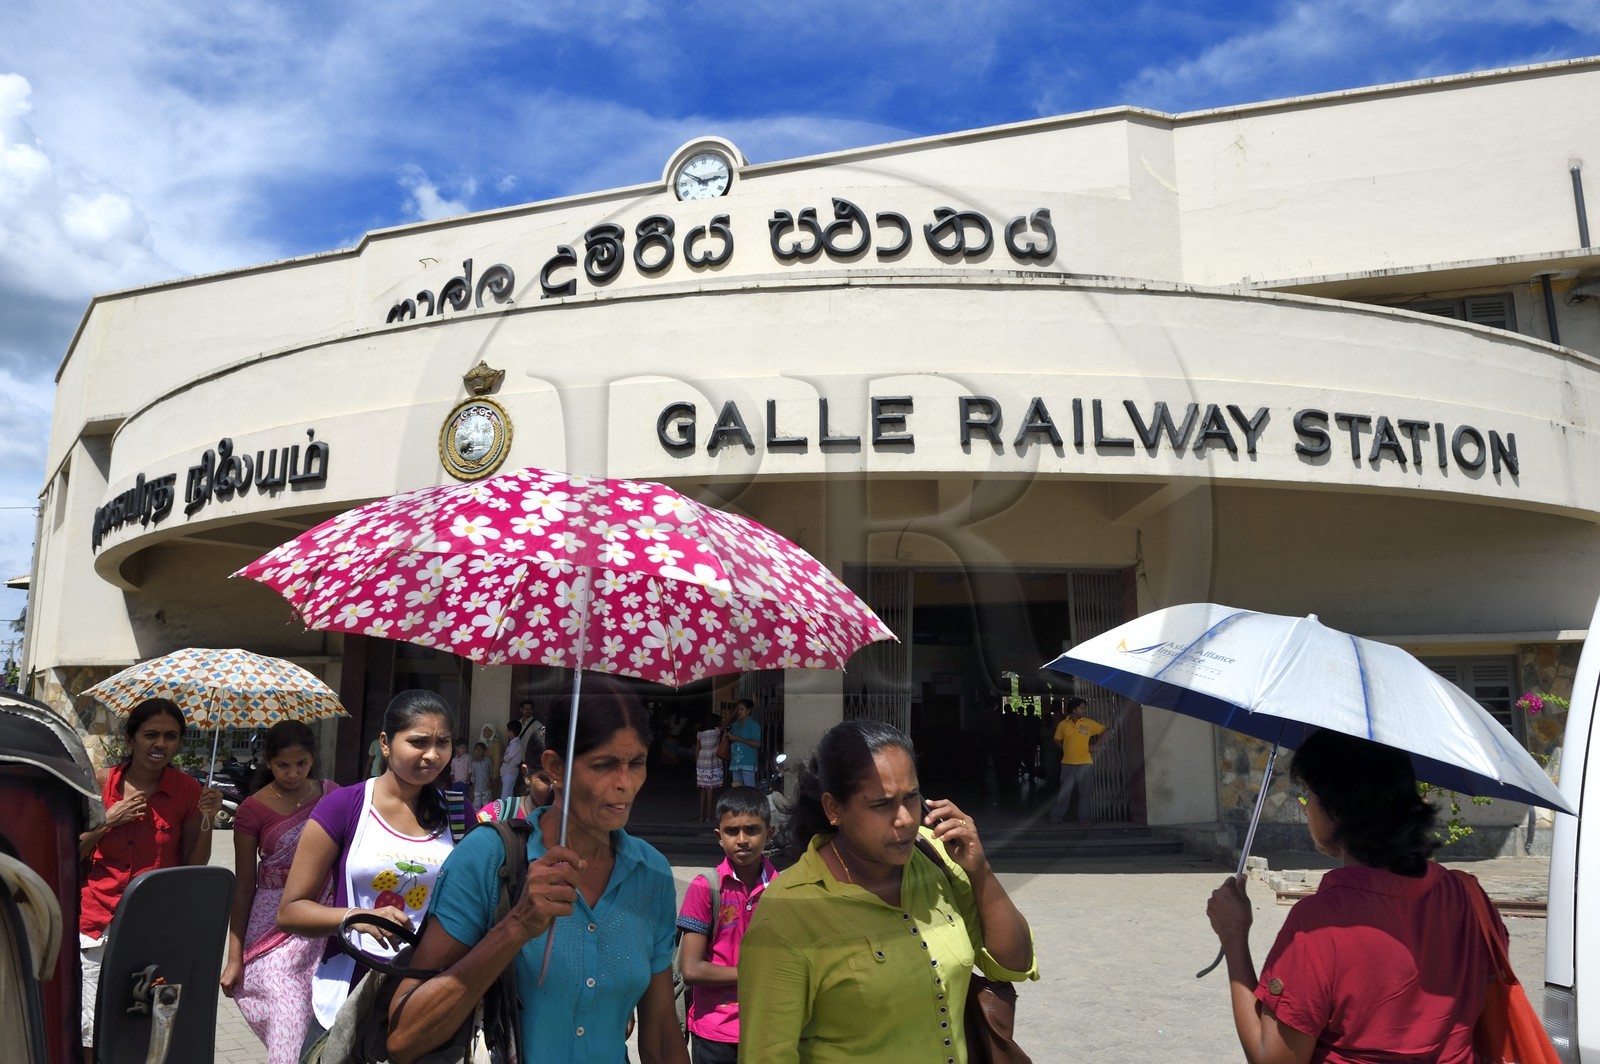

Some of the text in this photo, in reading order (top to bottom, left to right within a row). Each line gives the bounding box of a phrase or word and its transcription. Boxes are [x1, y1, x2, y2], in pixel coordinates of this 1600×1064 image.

[656, 395, 1521, 480] GALLE RAILWAY STATION
[1156, 645, 1206, 664] Insuance
[1165, 641, 1194, 654] Asi
